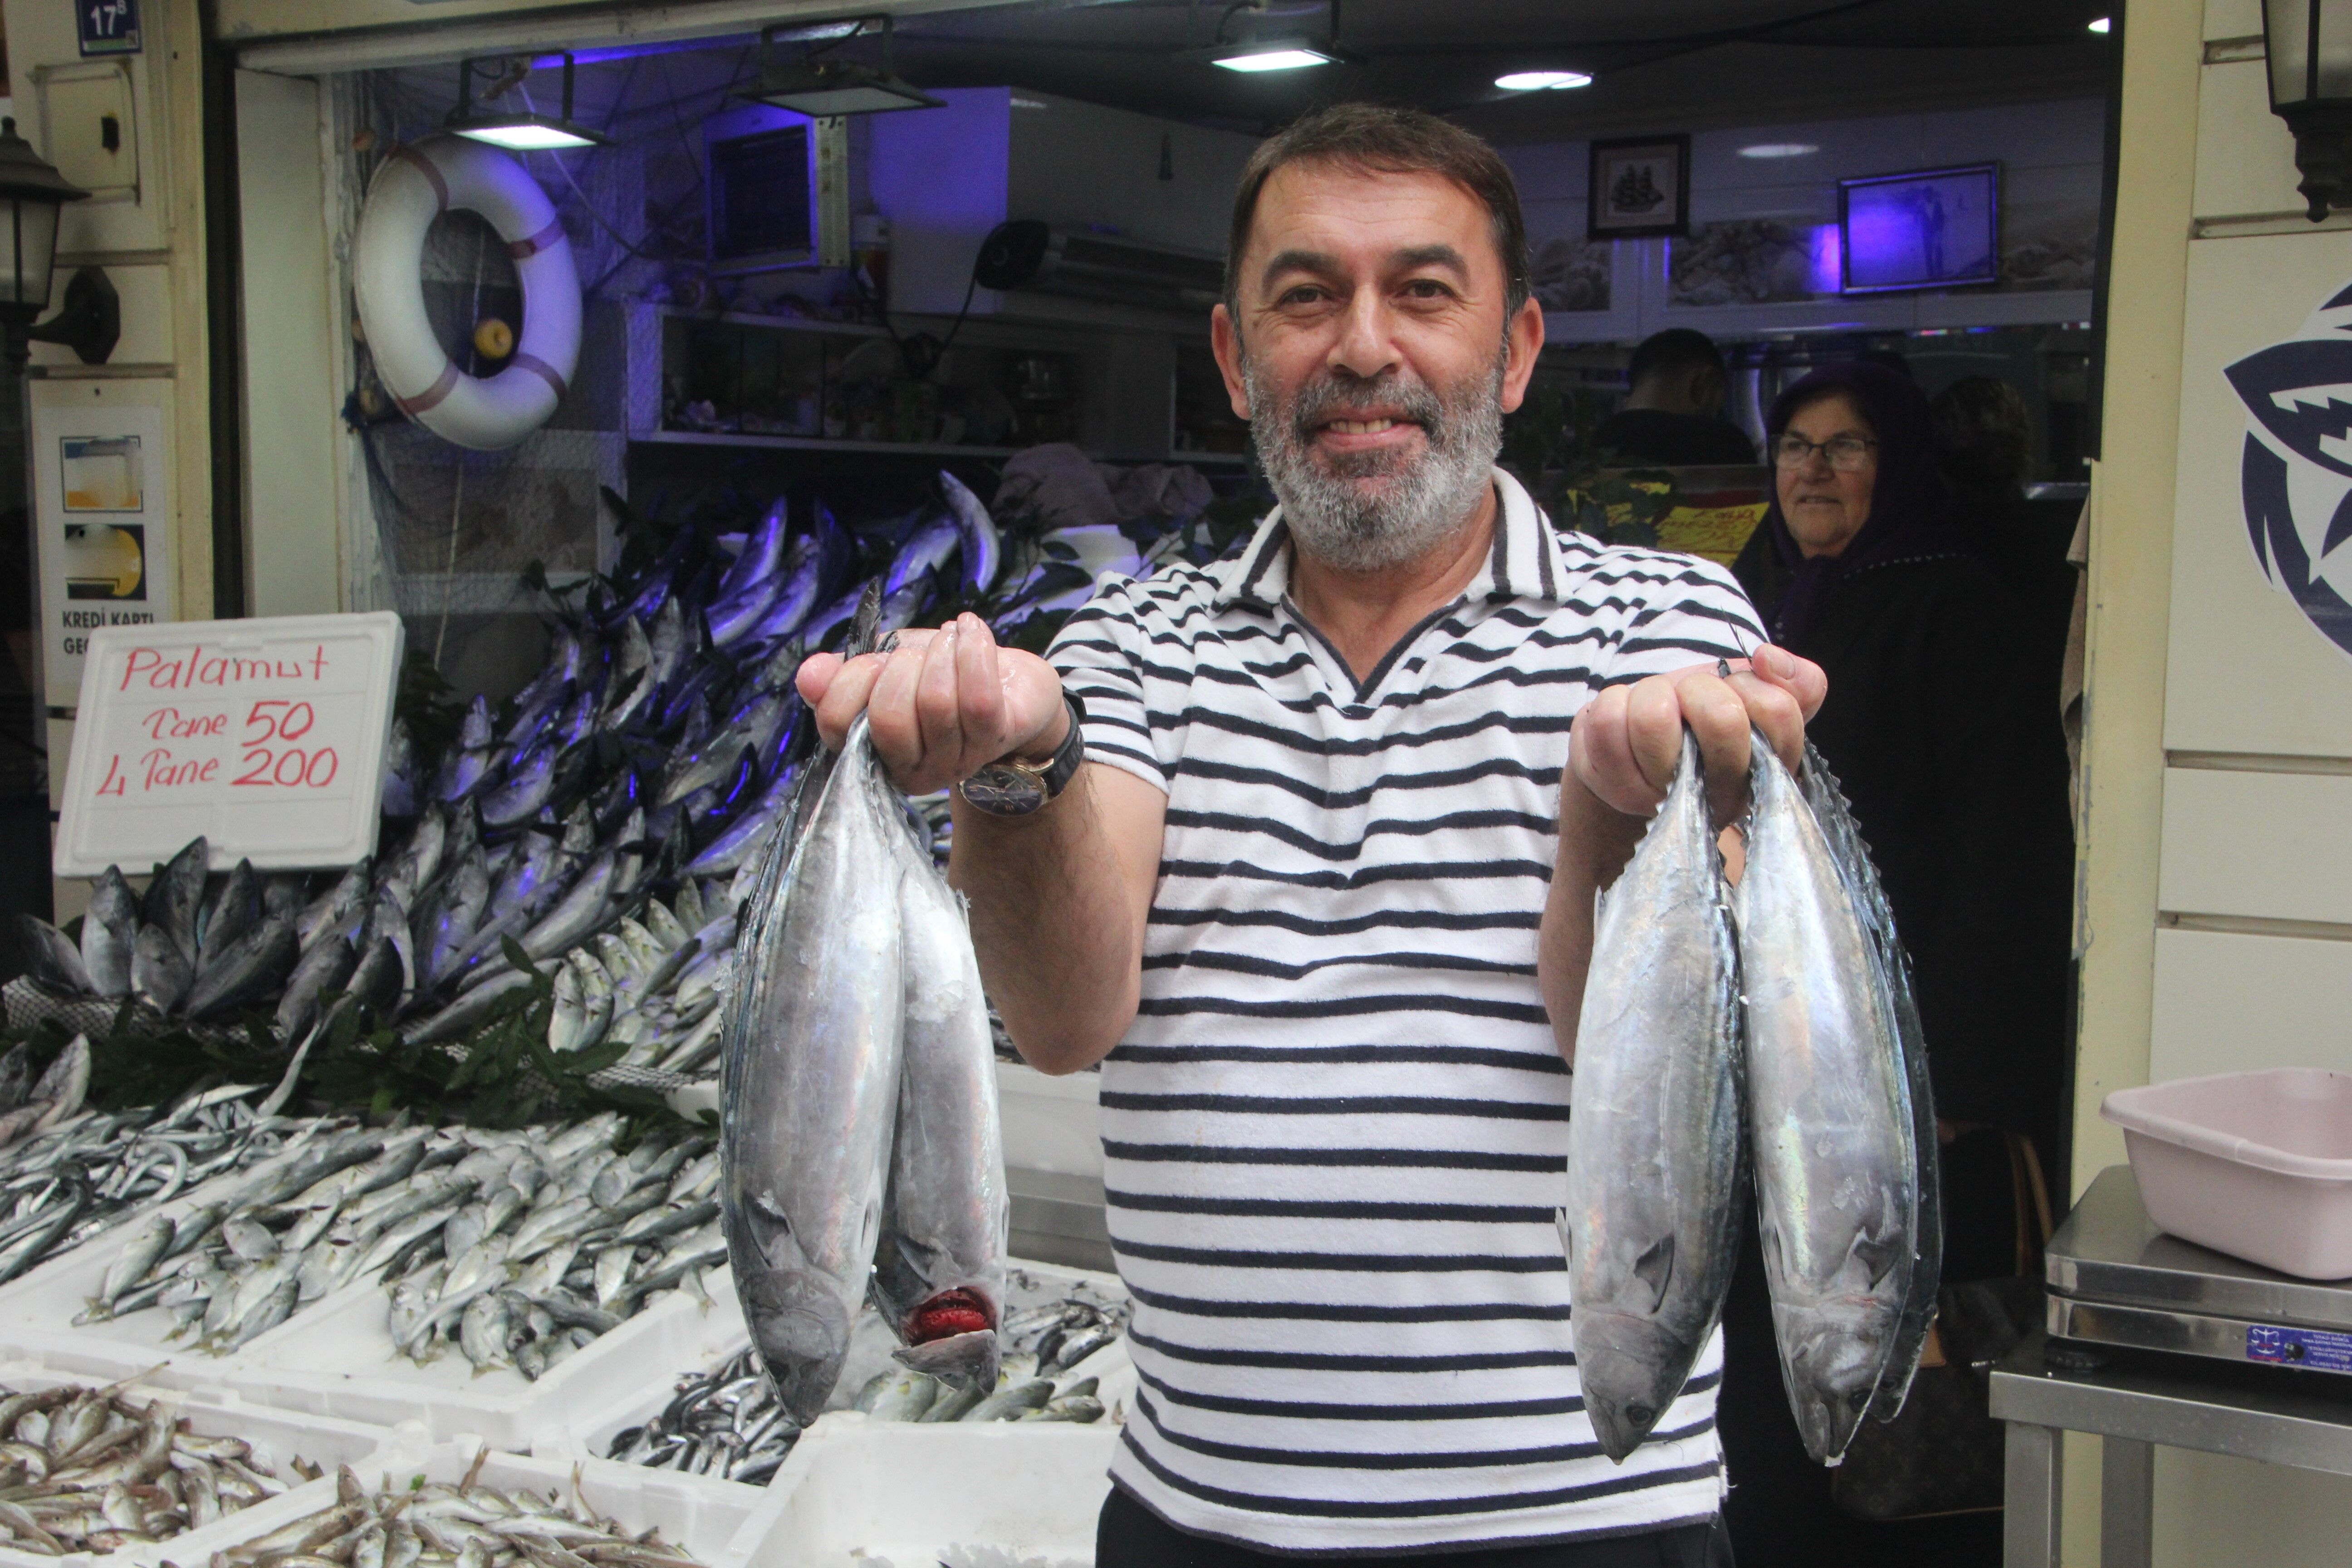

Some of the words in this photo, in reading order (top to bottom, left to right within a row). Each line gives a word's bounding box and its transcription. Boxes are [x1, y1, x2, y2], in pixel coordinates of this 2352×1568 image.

[62, 607, 105, 627] KREDİ
[120, 645, 328, 691] Palamut
[142, 707, 227, 740] Tane
[241, 700, 314, 747] 50
[96, 754, 125, 796] 4
[140, 748, 219, 791] Tane
[230, 747, 338, 788] 200
